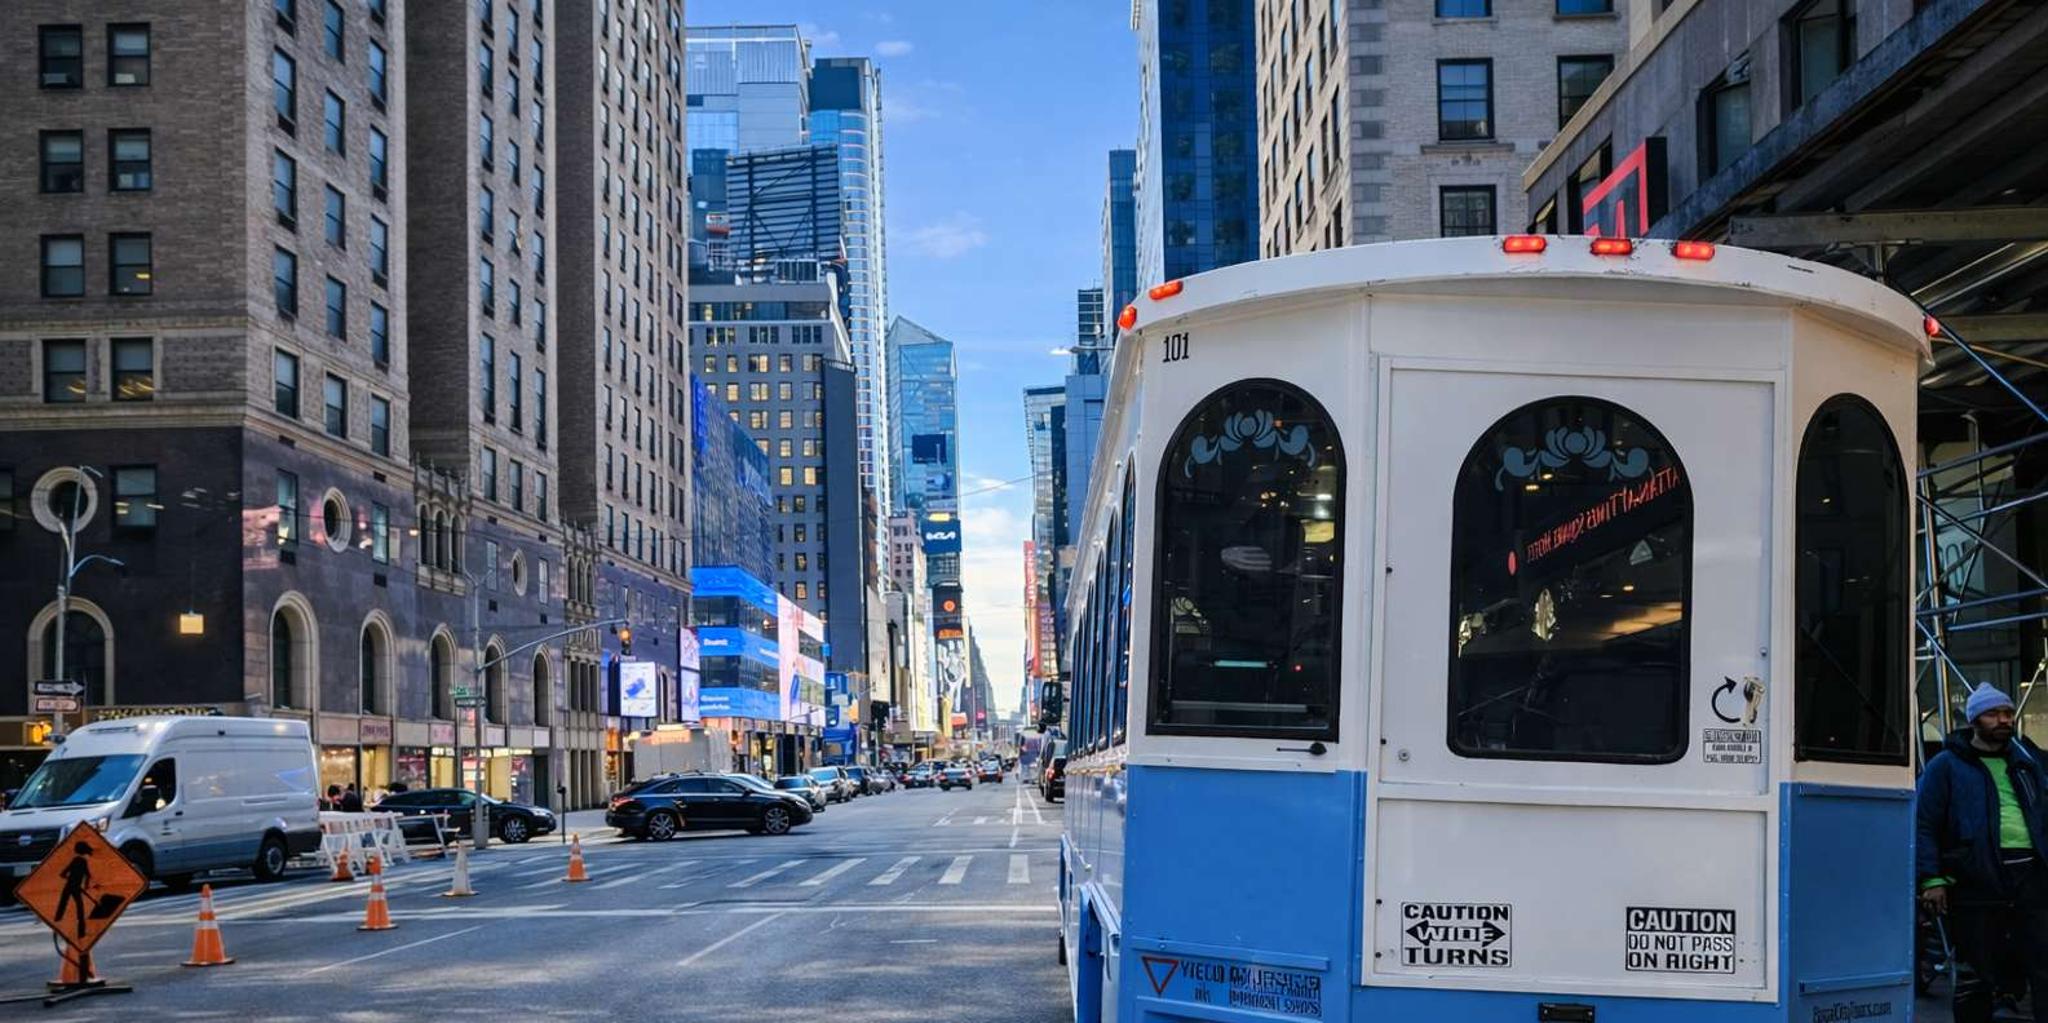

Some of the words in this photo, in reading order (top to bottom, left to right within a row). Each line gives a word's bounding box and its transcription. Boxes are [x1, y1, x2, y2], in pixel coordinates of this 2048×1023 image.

[1162, 332, 1190, 363] 101
[1404, 904, 1509, 921] CAUTION
[1629, 909, 1732, 933] CAUTION
[1416, 926, 1497, 942] WIDE
[1628, 934, 1650, 950] DO
[1655, 935, 1687, 952] NOT
[1692, 936, 1733, 952] PASS
[1404, 947, 1509, 966] TURNS
[1629, 952, 1658, 968] ON
[1666, 953, 1732, 970] RIGHT
